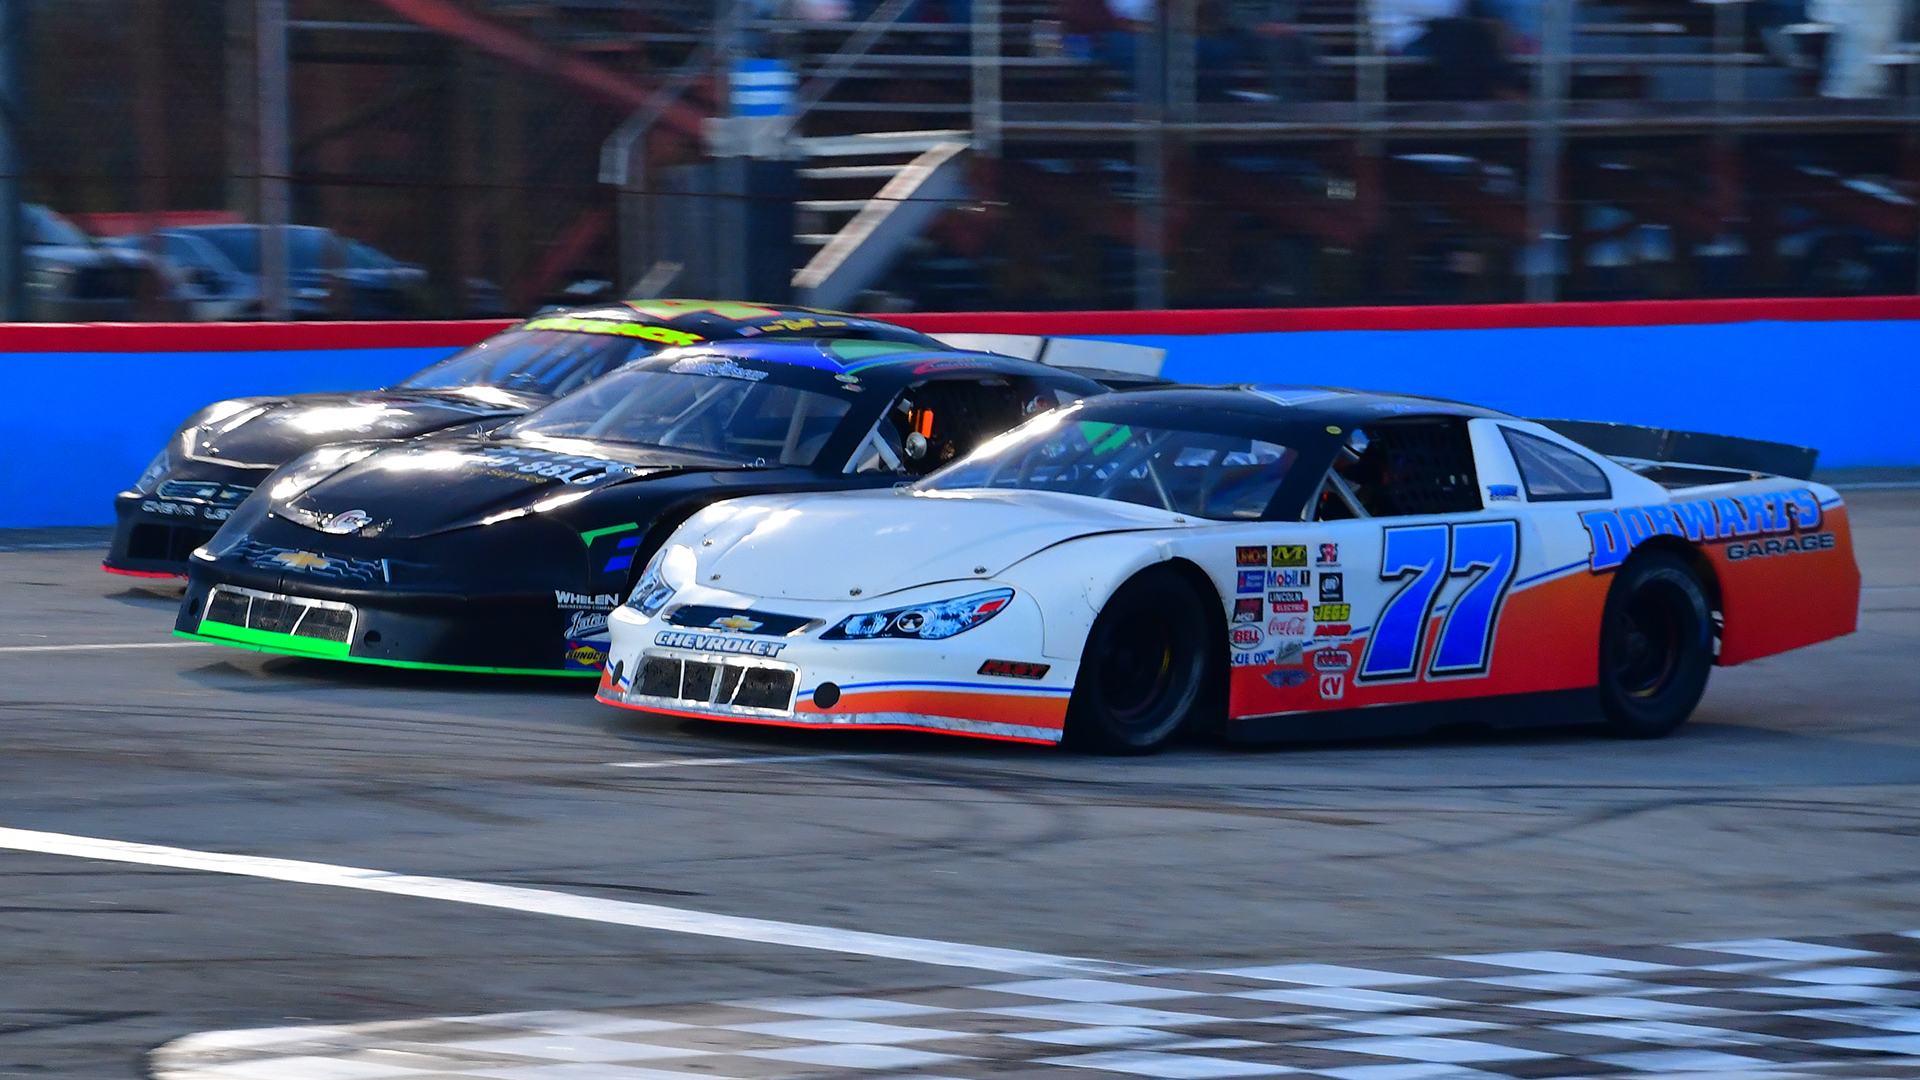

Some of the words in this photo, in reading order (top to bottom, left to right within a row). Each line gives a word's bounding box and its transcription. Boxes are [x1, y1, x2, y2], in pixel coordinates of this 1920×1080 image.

[1726, 531, 1836, 562] GARAGE
[1267, 570, 1298, 586] Mobil
[554, 589, 619, 606] WHELEN
[1269, 592, 1302, 602] LINCOLN
[1357, 519, 1521, 682] 77
[1276, 603, 1305, 612] ELECTRIC
[1313, 604, 1350, 621] JEGS
[654, 631, 787, 657] CHEVROLET
[1233, 630, 1260, 642] BELL
[565, 649, 607, 661] SUNOCO
[1254, 653, 1268, 664] OX
[983, 662, 1044, 676] FAST
[1322, 677, 1342, 695] CV
